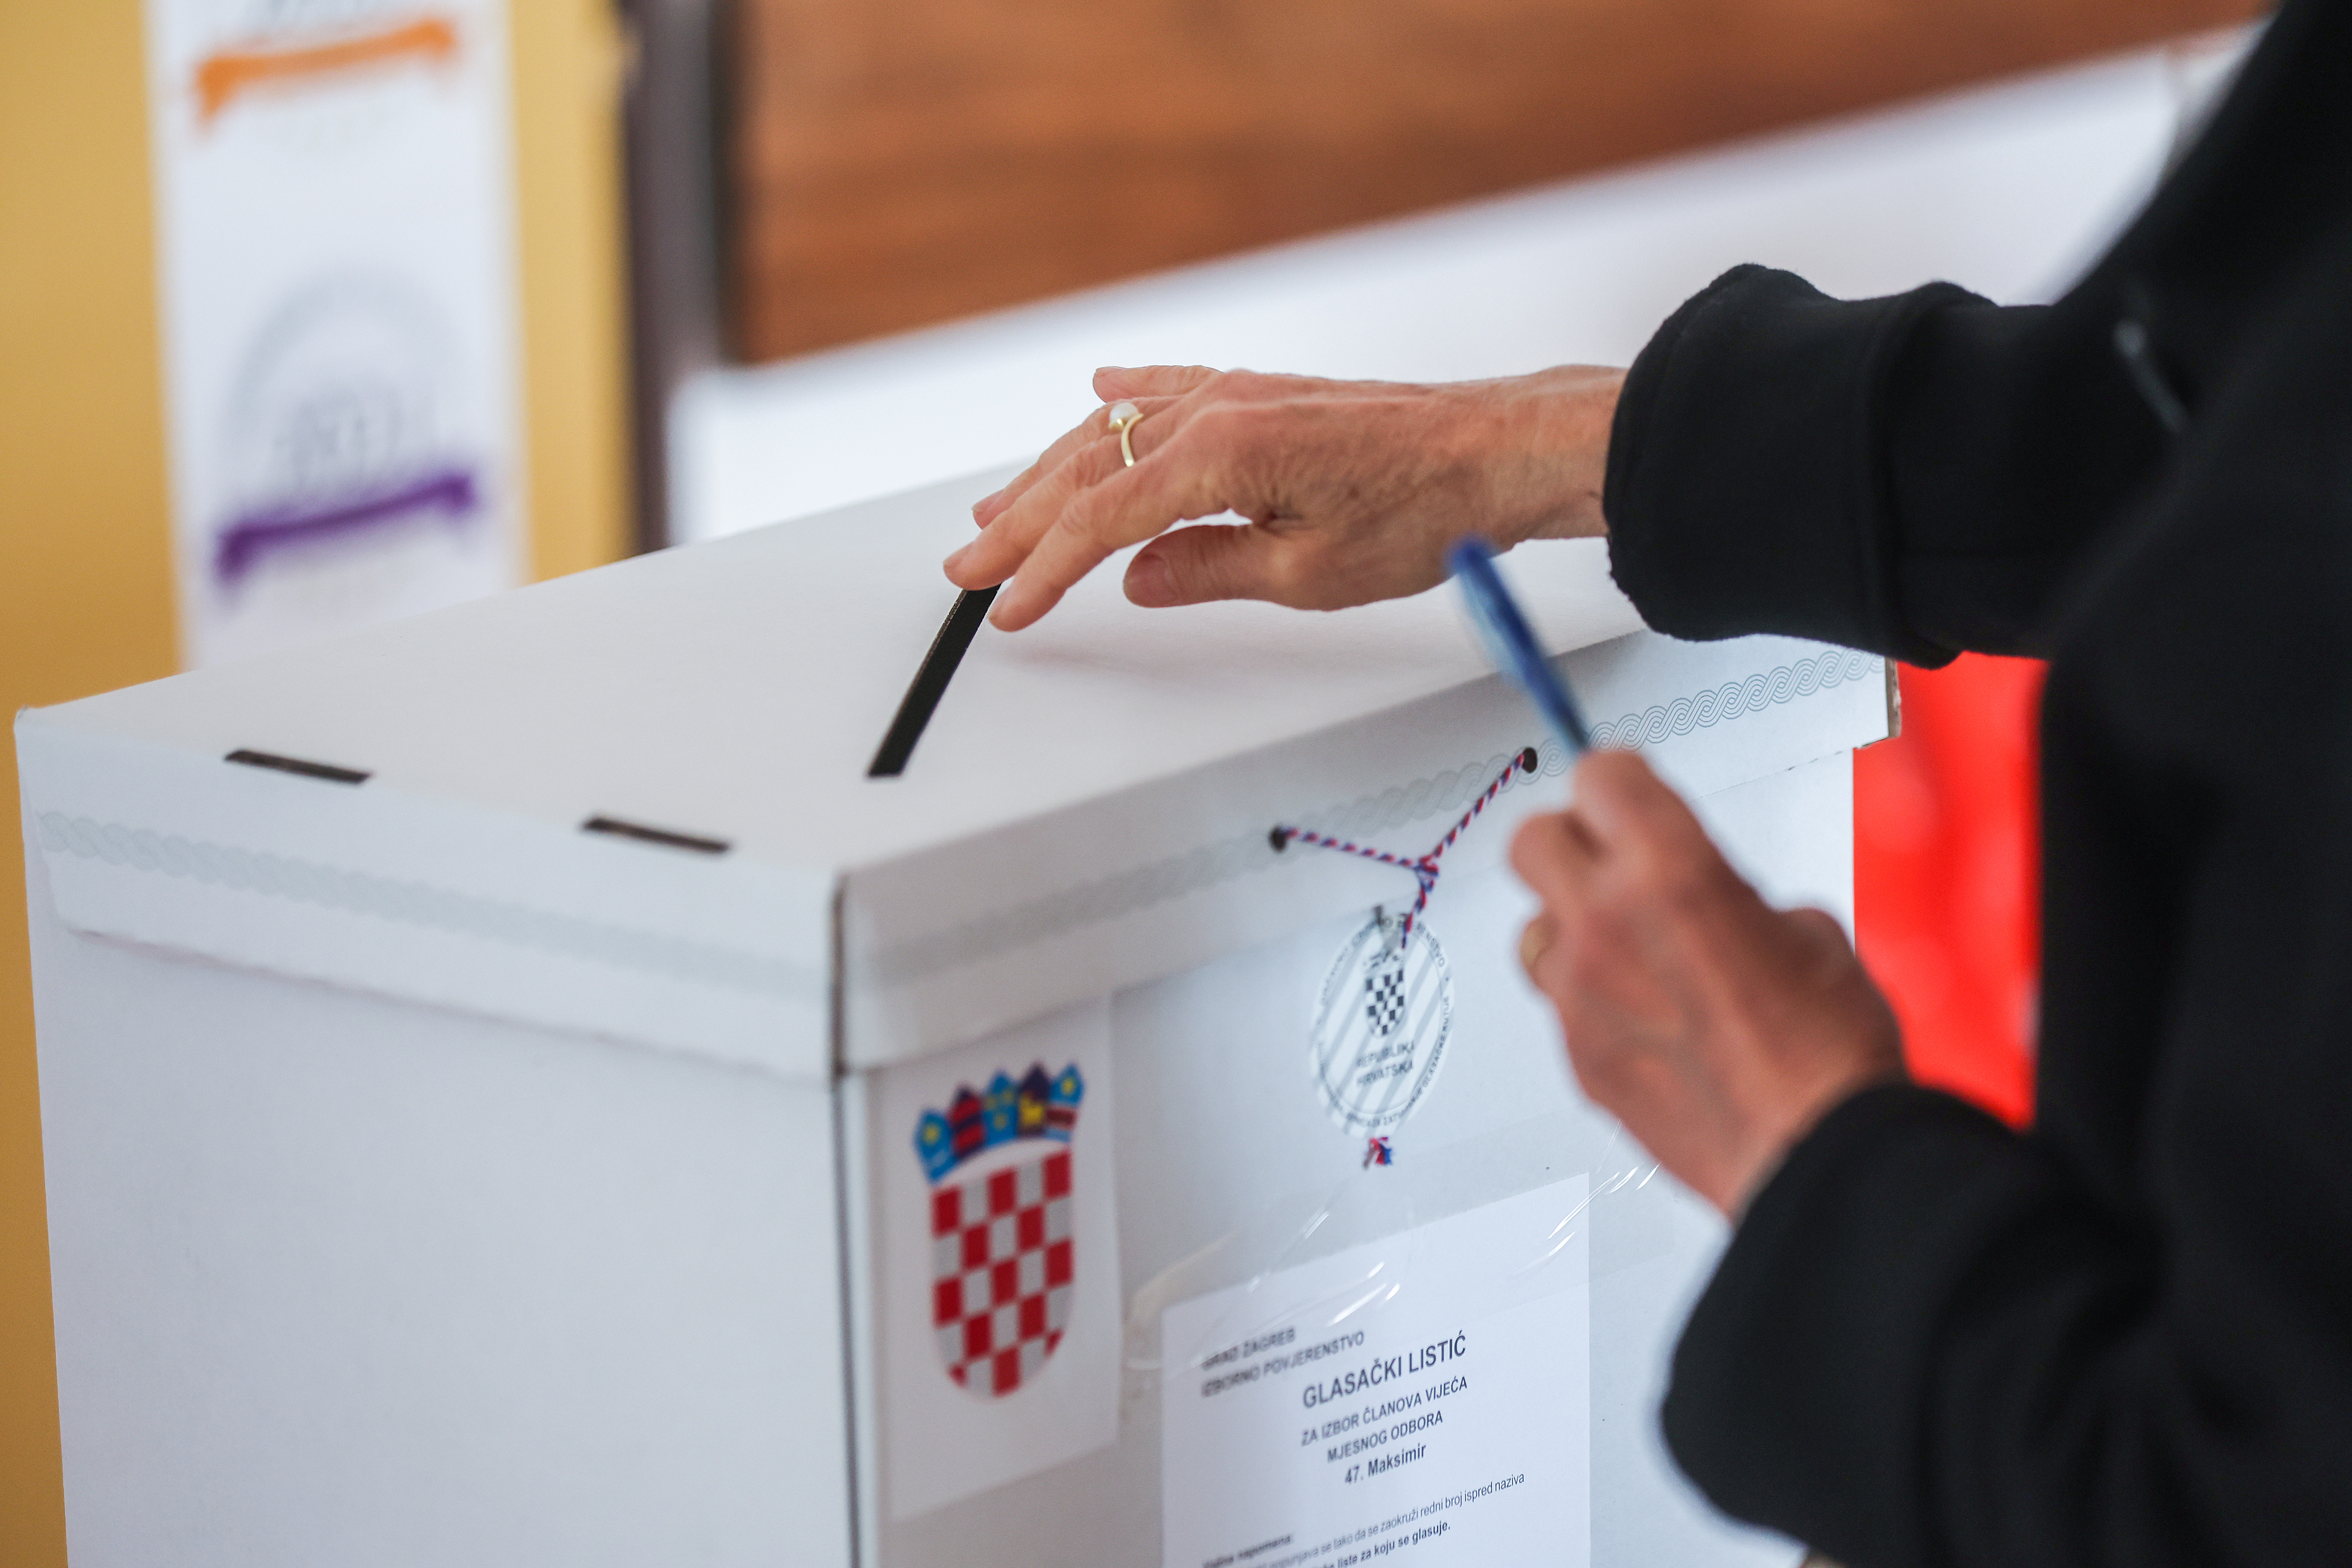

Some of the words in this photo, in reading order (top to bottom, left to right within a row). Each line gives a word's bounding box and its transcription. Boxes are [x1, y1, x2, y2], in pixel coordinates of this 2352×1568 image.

[1264, 1330, 1365, 1376] POVJERENSTVO
[1303, 1356, 1402, 1409] GLASAČKI
[1409, 1330, 1466, 1374] LISTIĆ
[1301, 1427, 1318, 1446] ZA
[1321, 1412, 1359, 1439] IZBOR
[1362, 1392, 1422, 1424] ČLANOVA
[1425, 1375, 1468, 1402] VIJEĆA
[1327, 1430, 1388, 1463] MJESNOG
[1391, 1410, 1443, 1440] ODBORA
[1344, 1464, 1364, 1484] 47.
[1368, 1442, 1426, 1477] Maksimir
[1321, 1542, 1332, 1555] se
[1334, 1532, 1354, 1550] tako
[1354, 1528, 1366, 1542] da
[1367, 1524, 1379, 1537] se
[1381, 1507, 1419, 1532] zaokruži
[1420, 1497, 1443, 1518] redni
[1445, 1491, 1463, 1507] broj
[1464, 1481, 1493, 1503] ispred
[1495, 1473, 1525, 1492] naziva
[1337, 1554, 1358, 1568] liste
[1361, 1548, 1372, 1563] za
[1374, 1539, 1395, 1556] koju
[1398, 1534, 1409, 1547] se
[1412, 1520, 1451, 1546] glasuje.
